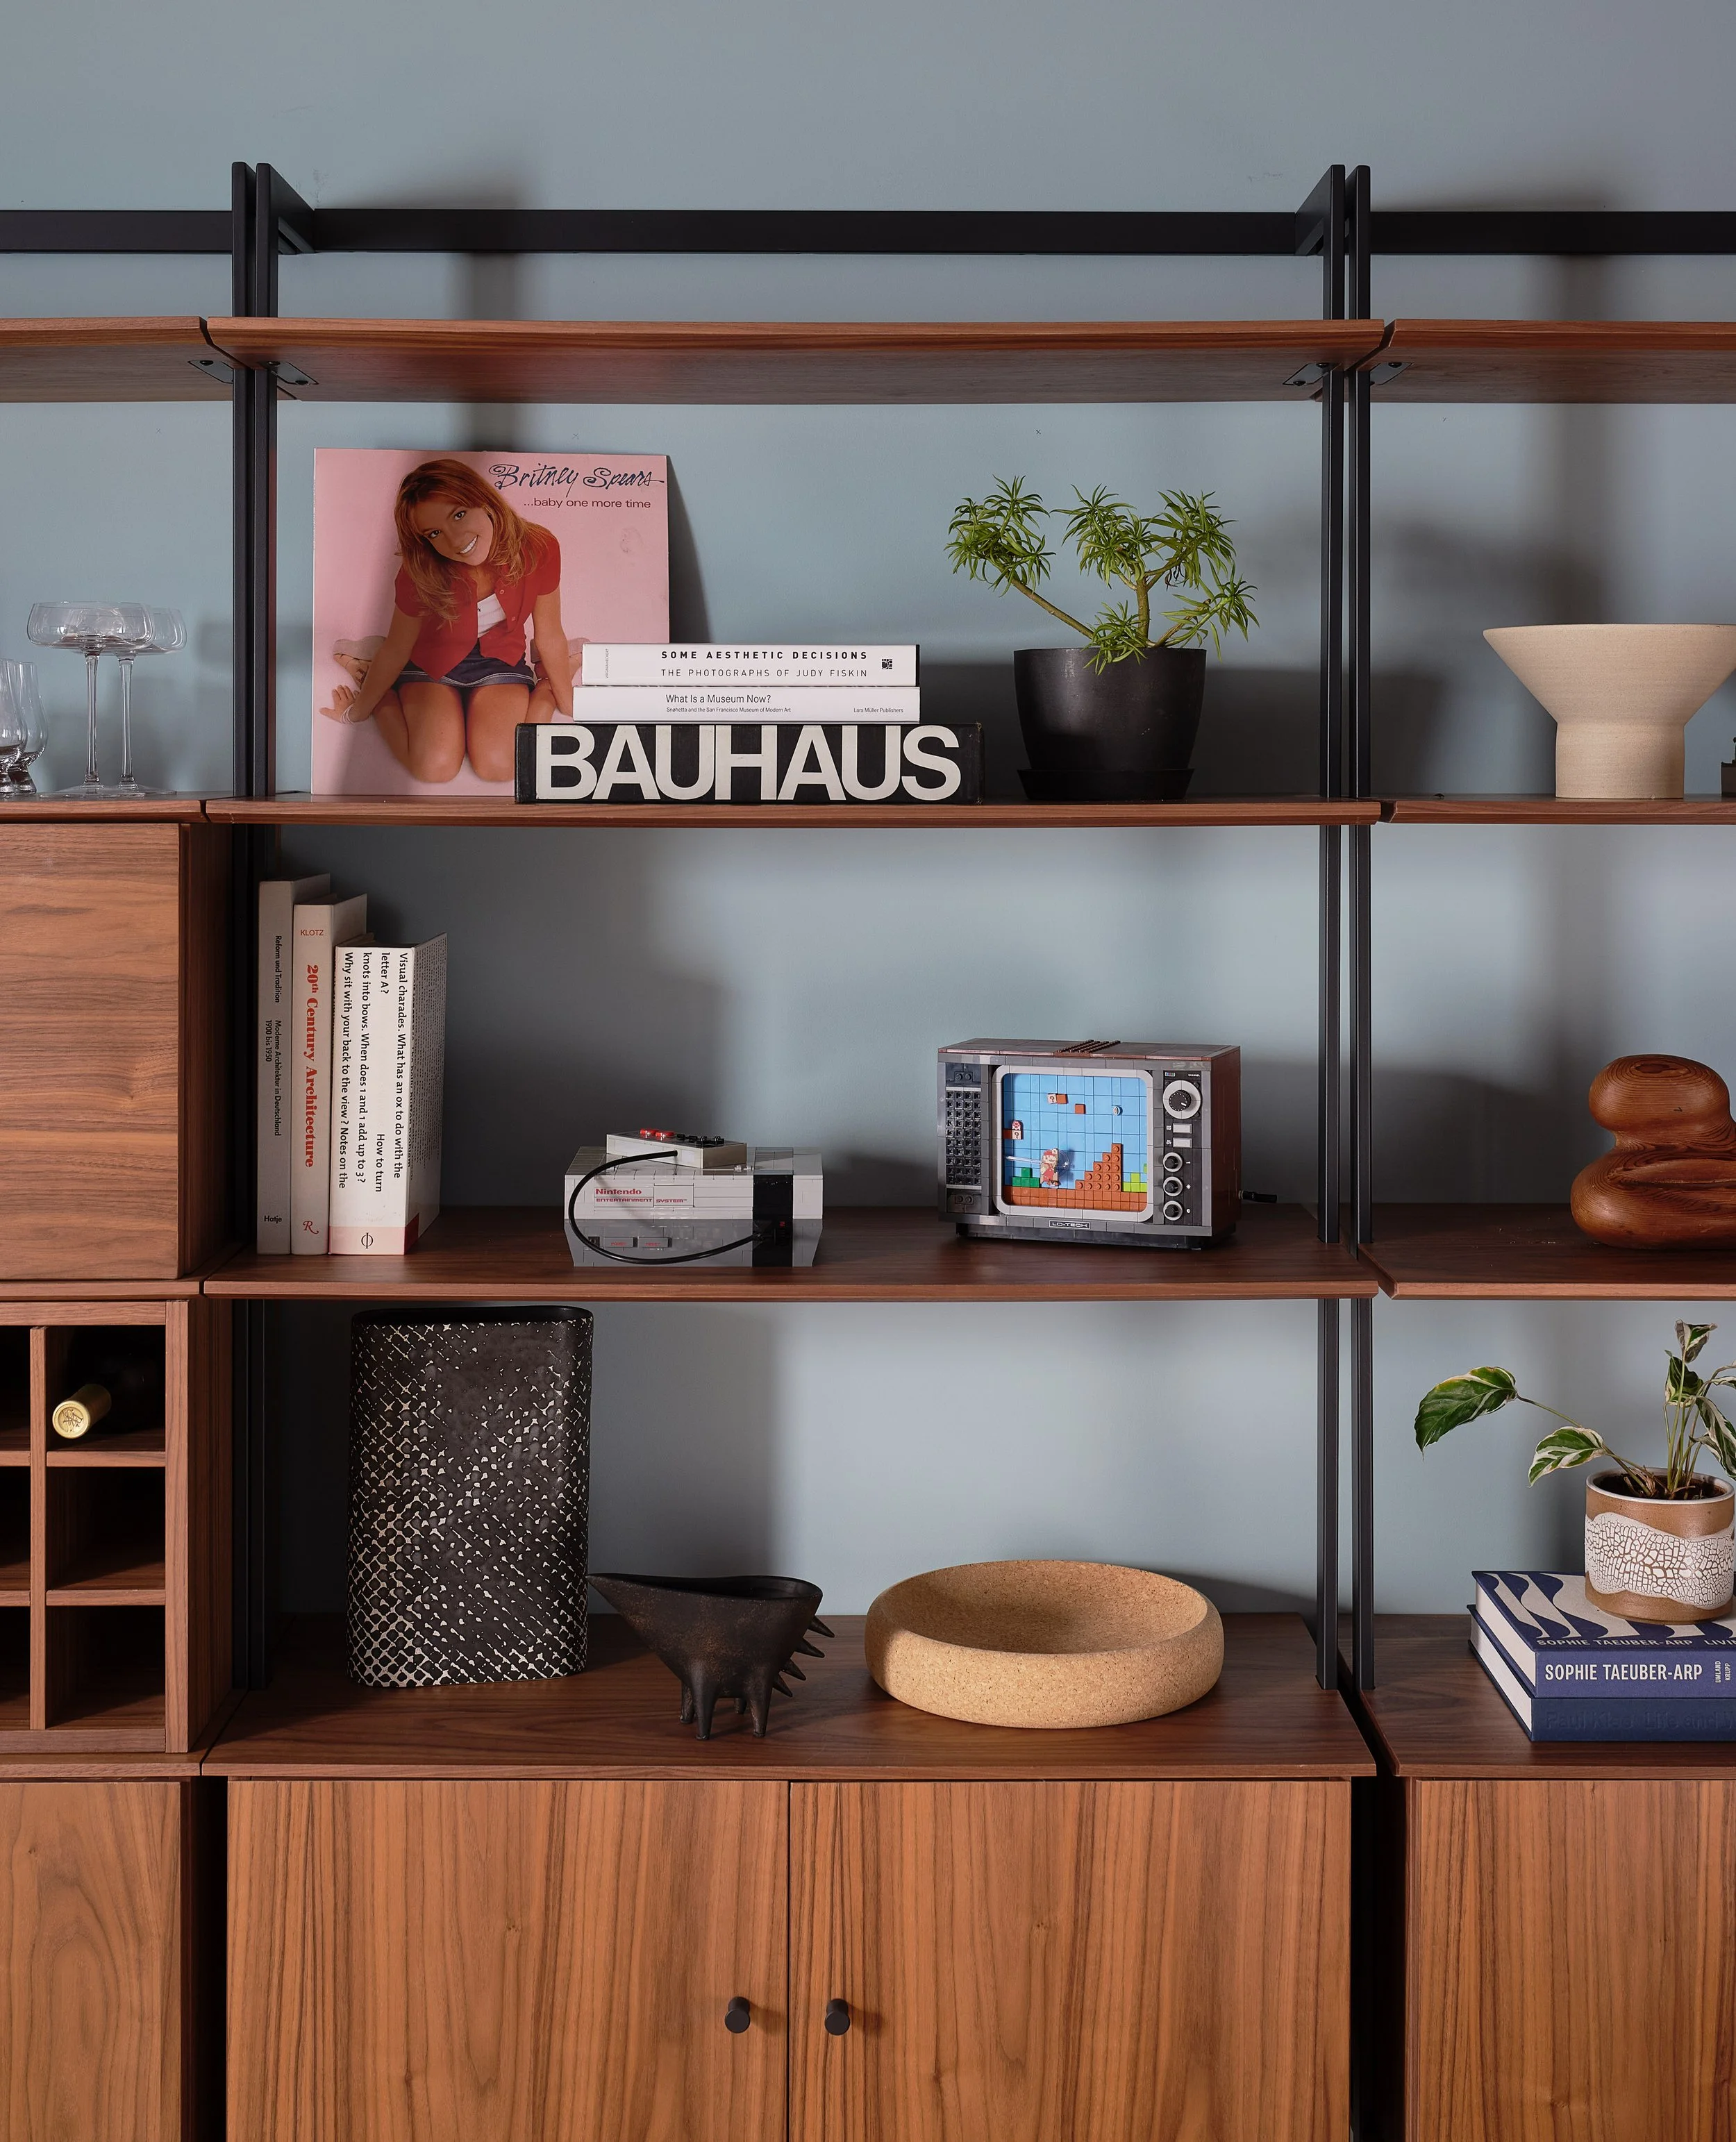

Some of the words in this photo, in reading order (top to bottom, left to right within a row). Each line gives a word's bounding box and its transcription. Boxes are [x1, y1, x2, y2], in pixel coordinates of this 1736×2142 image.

[488, 462, 579, 498] Britney
[583, 467, 665, 490] Spears
[625, 499, 651, 508] time
[708, 694, 744, 703] Museum
[535, 725, 961, 801] BAUHAUS
[342, 953, 353, 973] Why
[363, 952, 372, 978] knots
[381, 953, 390, 978] letter
[399, 953, 408, 982] Visual
[307, 964, 318, 993] 20th
[344, 977, 353, 987] sit
[362, 982, 371, 1001] into
[344, 991, 352, 1012] with
[398, 986, 407, 1031] charades.
[341, 1015, 349, 1037] your
[362, 1003, 370, 1030] bows.
[303, 998, 318, 1062] Century
[342, 1039, 351, 1062] back
[361, 1033, 369, 1061] When
[397, 1034, 406, 1060] What
[342, 1064, 350, 1074] to
[360, 1064, 369, 1086] does
[397, 1062, 406, 1078] has
[342, 1078, 350, 1093] the
[397, 1082, 402, 1093] an
[396, 1097, 402, 1107] ox
[306, 1066, 317, 1167] Architecture
[396, 1110, 403, 1120] to
[359, 1123, 367, 1141] add
[395, 1123, 403, 1135] do
[340, 1128, 349, 1155] Notes
[356, 1144, 364, 1157] up
[376, 1135, 385, 1155] How
[340, 1158, 346, 1169] on
[358, 1160, 365, 1169] to
[376, 1158, 384, 1168] to
[394, 1162, 403, 1178] the
[339, 1173, 348, 1188] the
[1545, 1664, 1597, 1680] SOPHIE
[1603, 1664, 1702, 1680] TAEUBER-ARP
